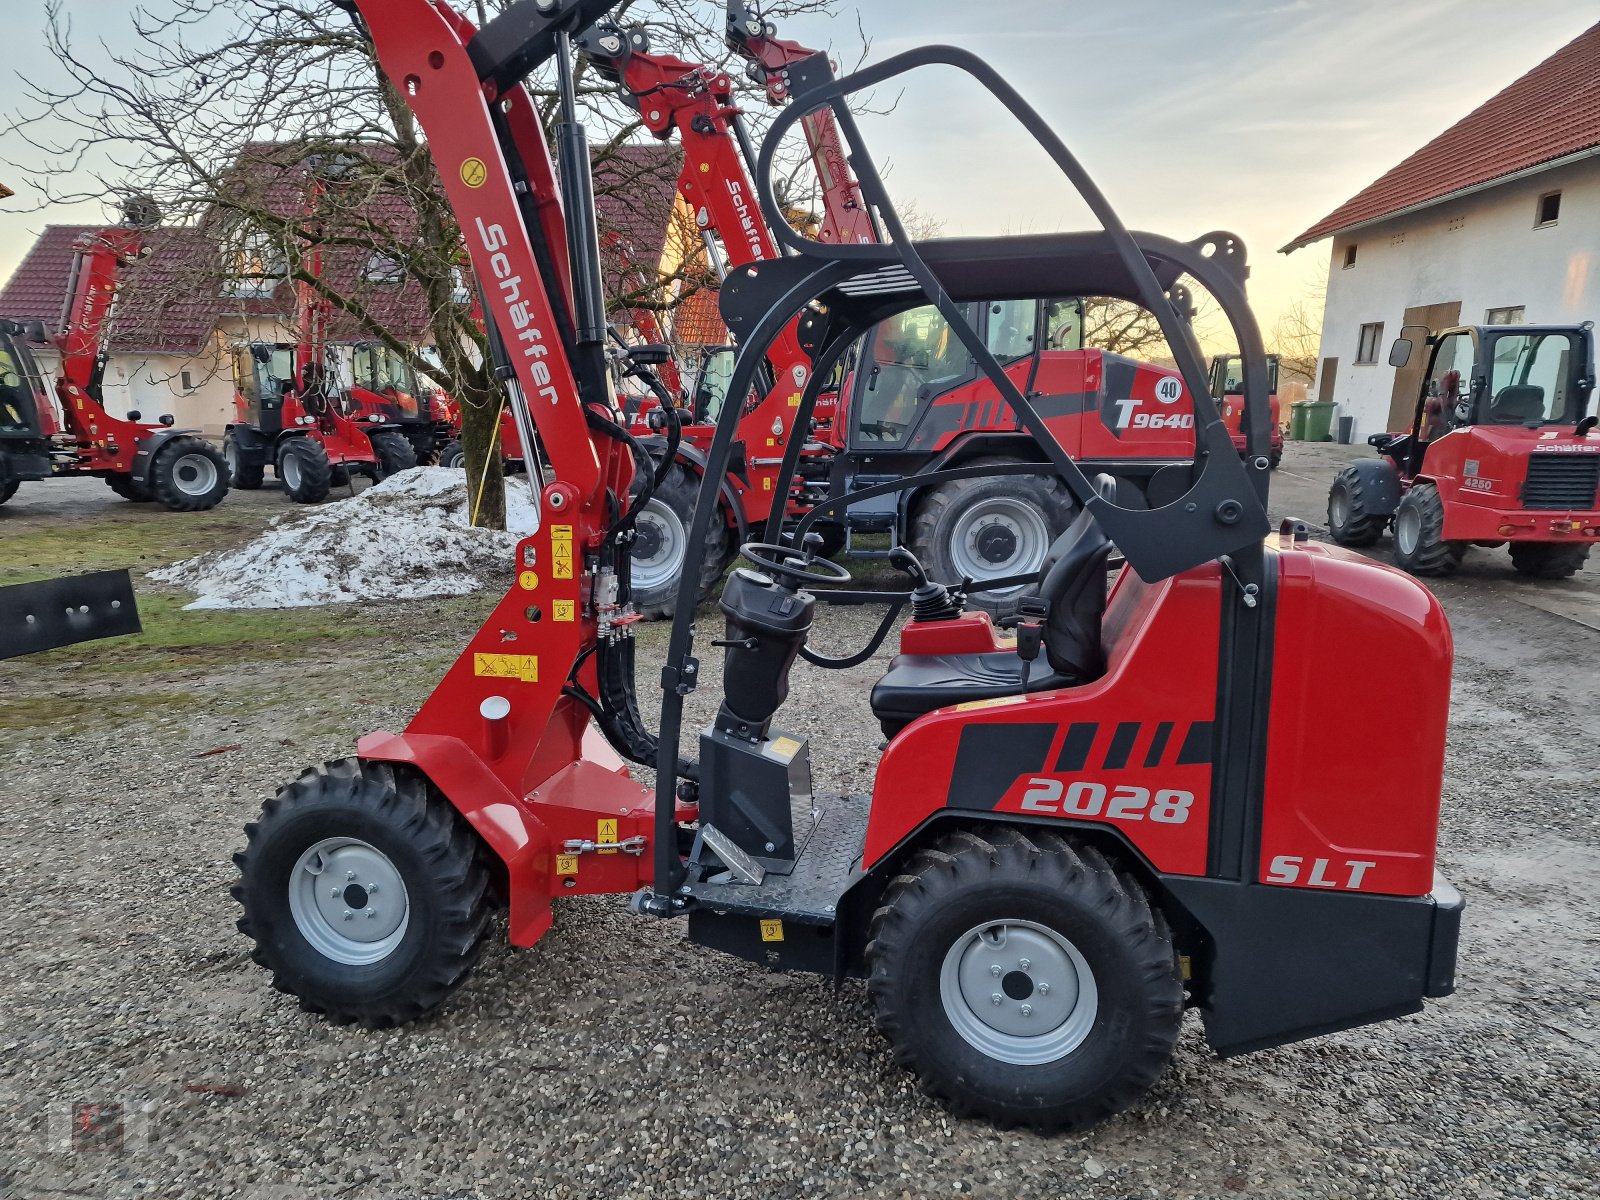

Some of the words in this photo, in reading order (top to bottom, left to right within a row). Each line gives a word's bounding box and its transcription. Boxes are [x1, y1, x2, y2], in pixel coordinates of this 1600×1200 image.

[475, 216, 559, 405] Schäffer
[1160, 381, 1177, 399] 40
[1115, 399, 1195, 429] T9640
[1532, 443, 1600, 452] Schäffer
[1464, 478, 1492, 490] 4250
[1020, 777, 1195, 824] 2028
[1266, 855, 1377, 889] SLT
